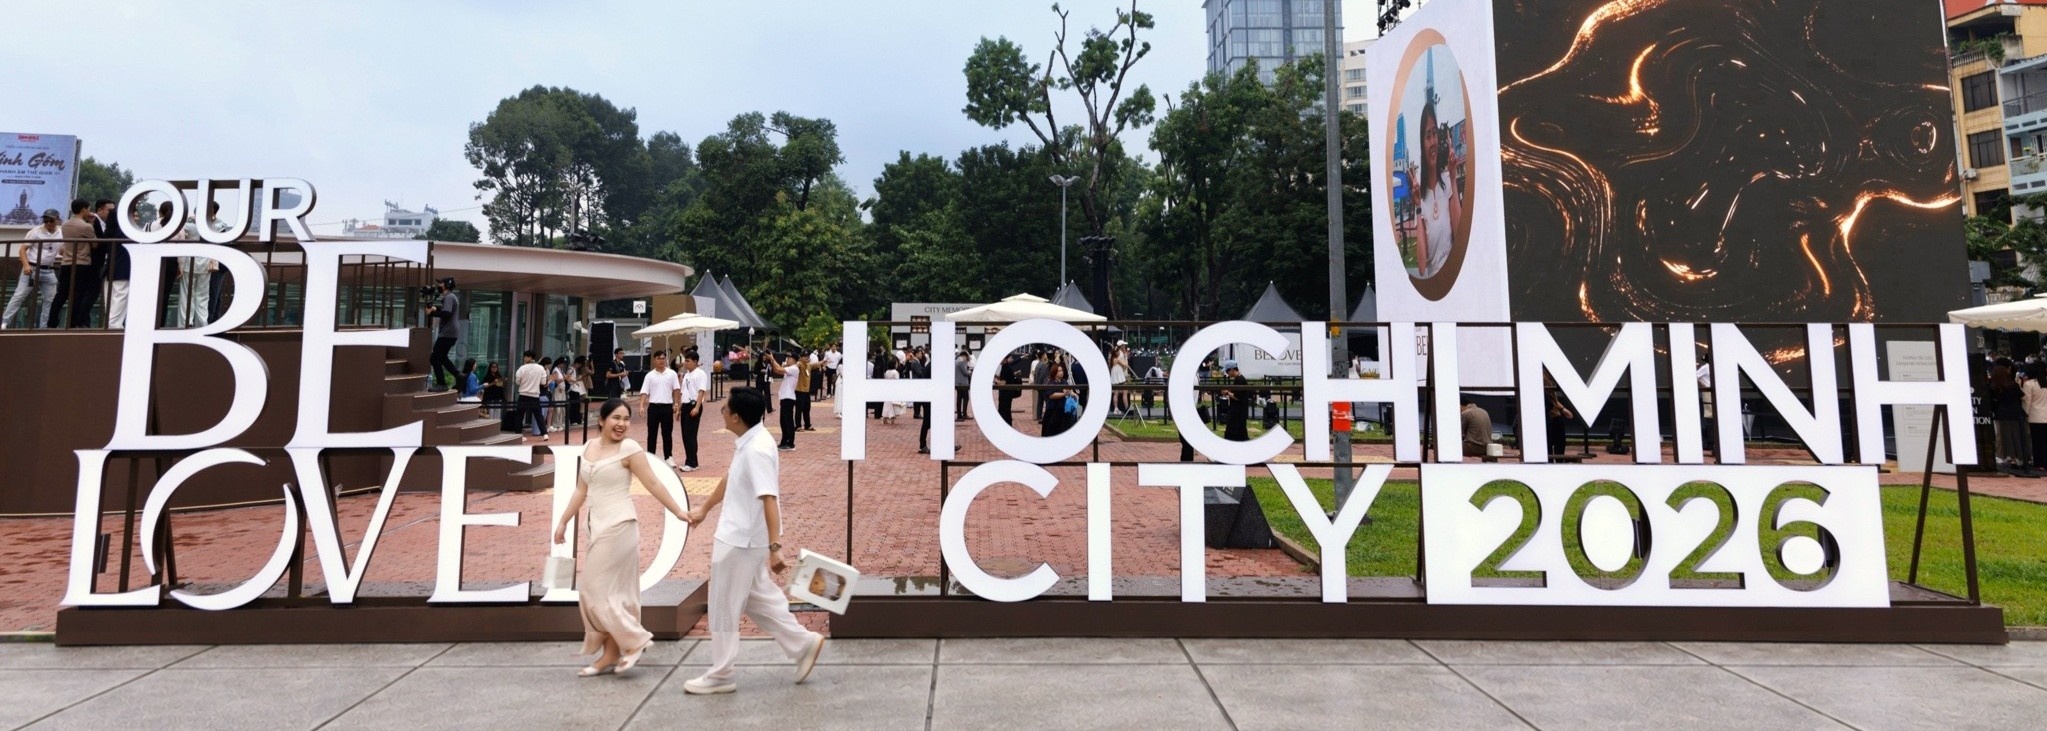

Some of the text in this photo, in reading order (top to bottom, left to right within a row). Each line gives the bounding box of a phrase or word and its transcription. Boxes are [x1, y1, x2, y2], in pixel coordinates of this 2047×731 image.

[28, 153, 65, 171] Gốm
[117, 178, 316, 243] OUR
[103, 241, 428, 450] BE
[924, 306, 941, 314] CITY
[841, 319, 1978, 466] HO CHI MINH
[60, 446, 689, 612] LOVED
[939, 460, 1842, 604] CITY 2026
